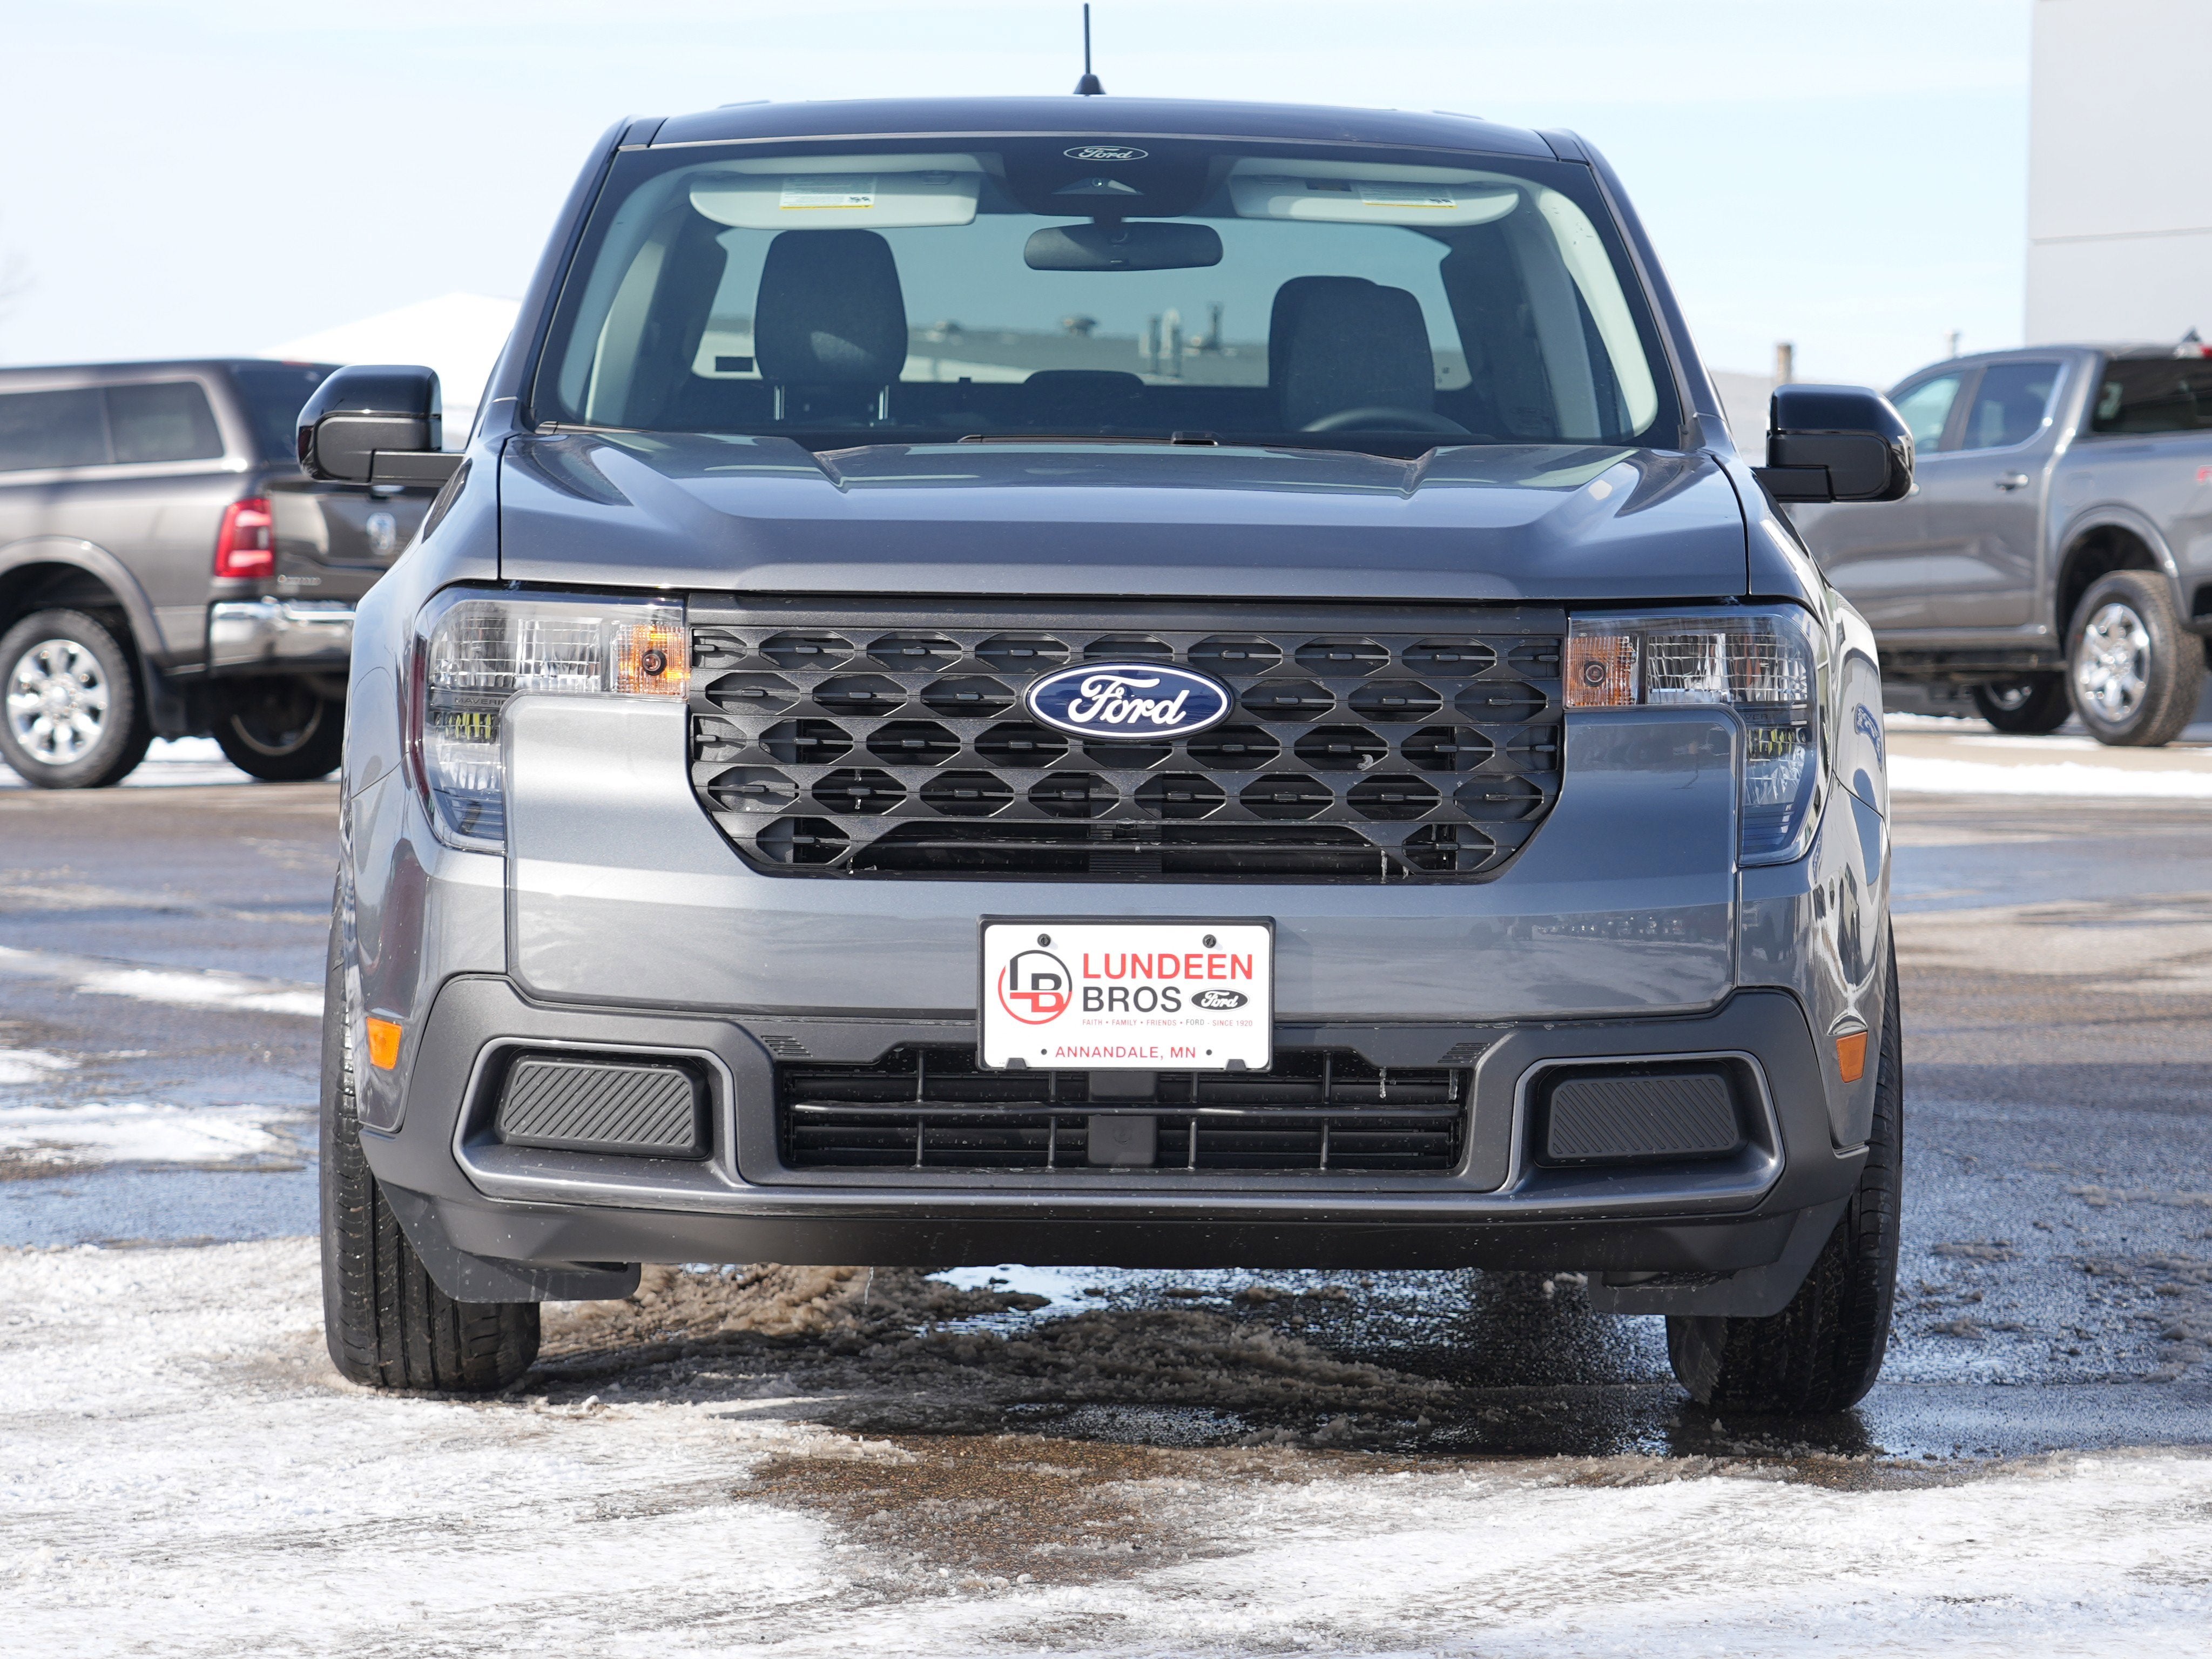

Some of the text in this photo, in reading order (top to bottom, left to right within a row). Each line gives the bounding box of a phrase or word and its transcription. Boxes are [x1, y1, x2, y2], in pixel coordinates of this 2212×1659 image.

[1078, 147, 1134, 159] Ford
[1067, 674, 1190, 725] Ford
[1083, 953, 1252, 980] LUNDEEN
[1082, 986, 1182, 1013] BROS
[1201, 990, 1239, 1008] Ford
[1055, 1046, 1196, 1060] ANNANDALE, MN
